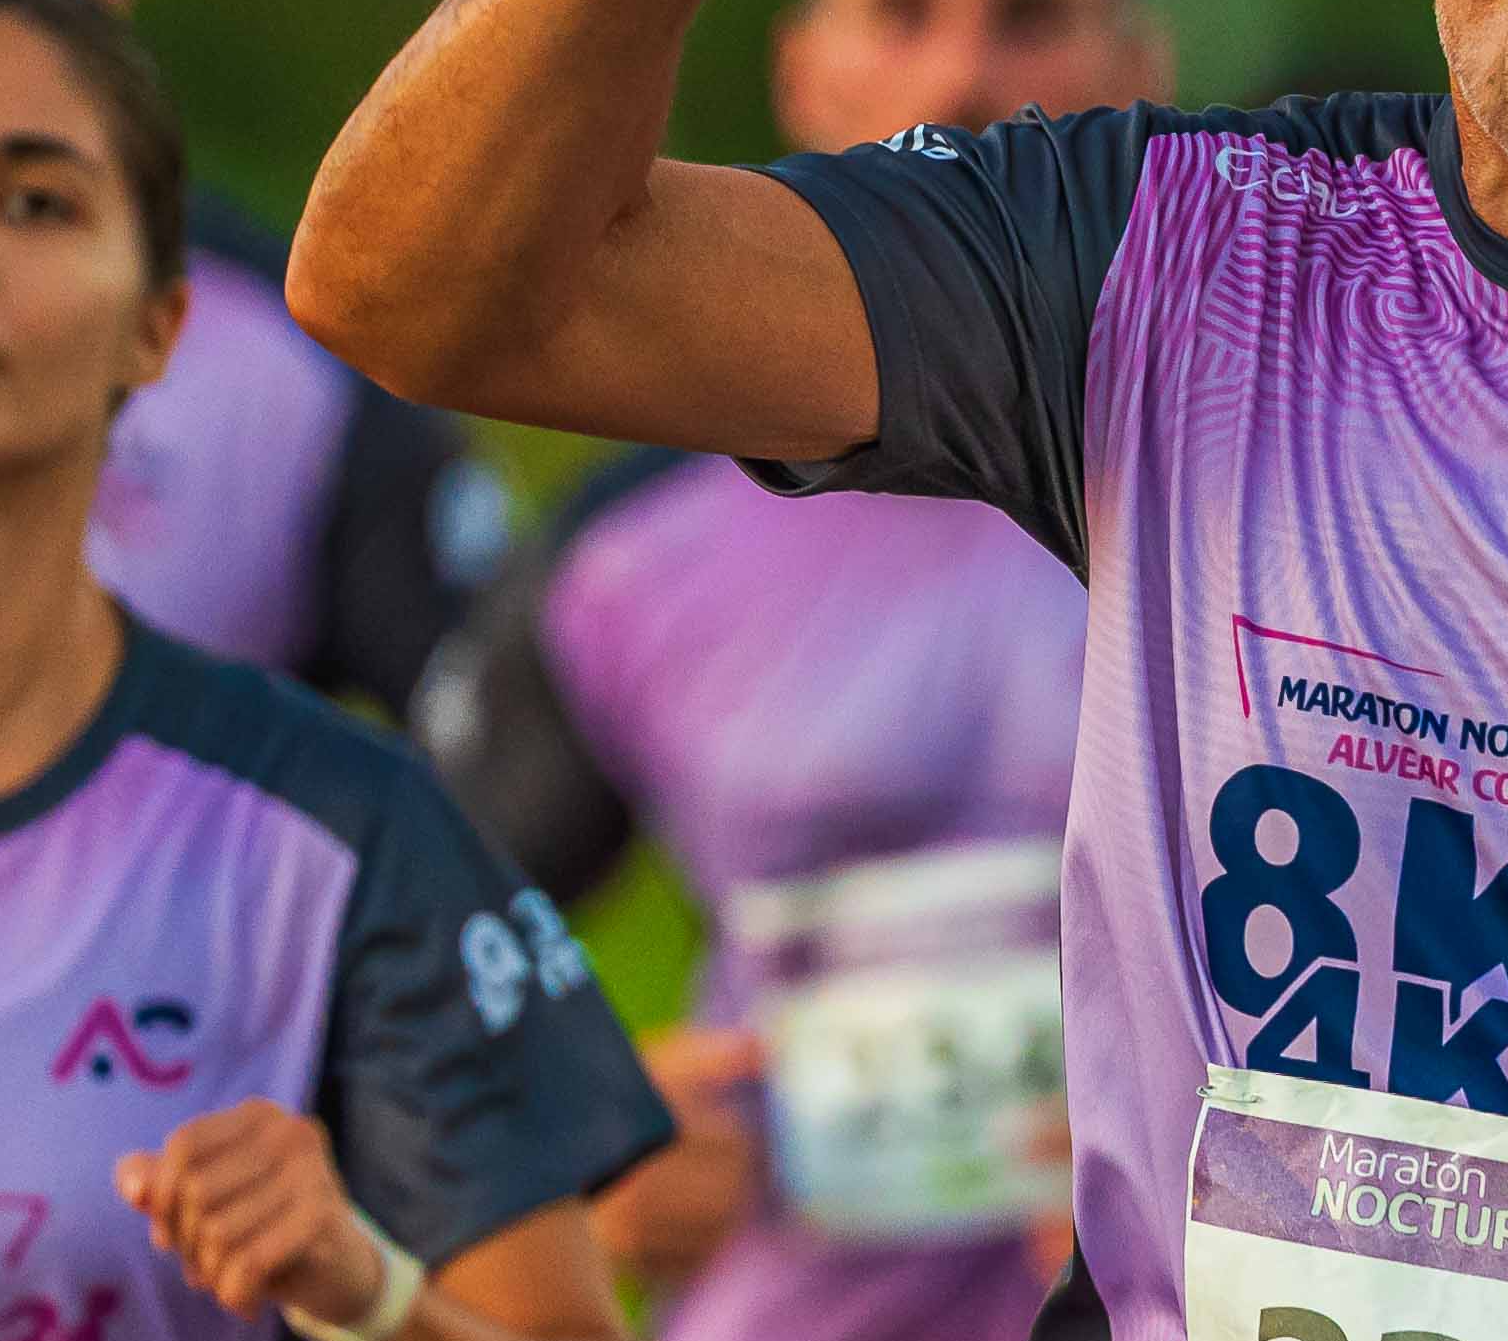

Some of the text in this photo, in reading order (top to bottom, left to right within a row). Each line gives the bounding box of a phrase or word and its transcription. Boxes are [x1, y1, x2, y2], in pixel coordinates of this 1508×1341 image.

[1277, 675, 1449, 745] MARATON
[1327, 734, 1461, 796] ALVEAR
[1319, 1133, 1487, 1200] Maratón
